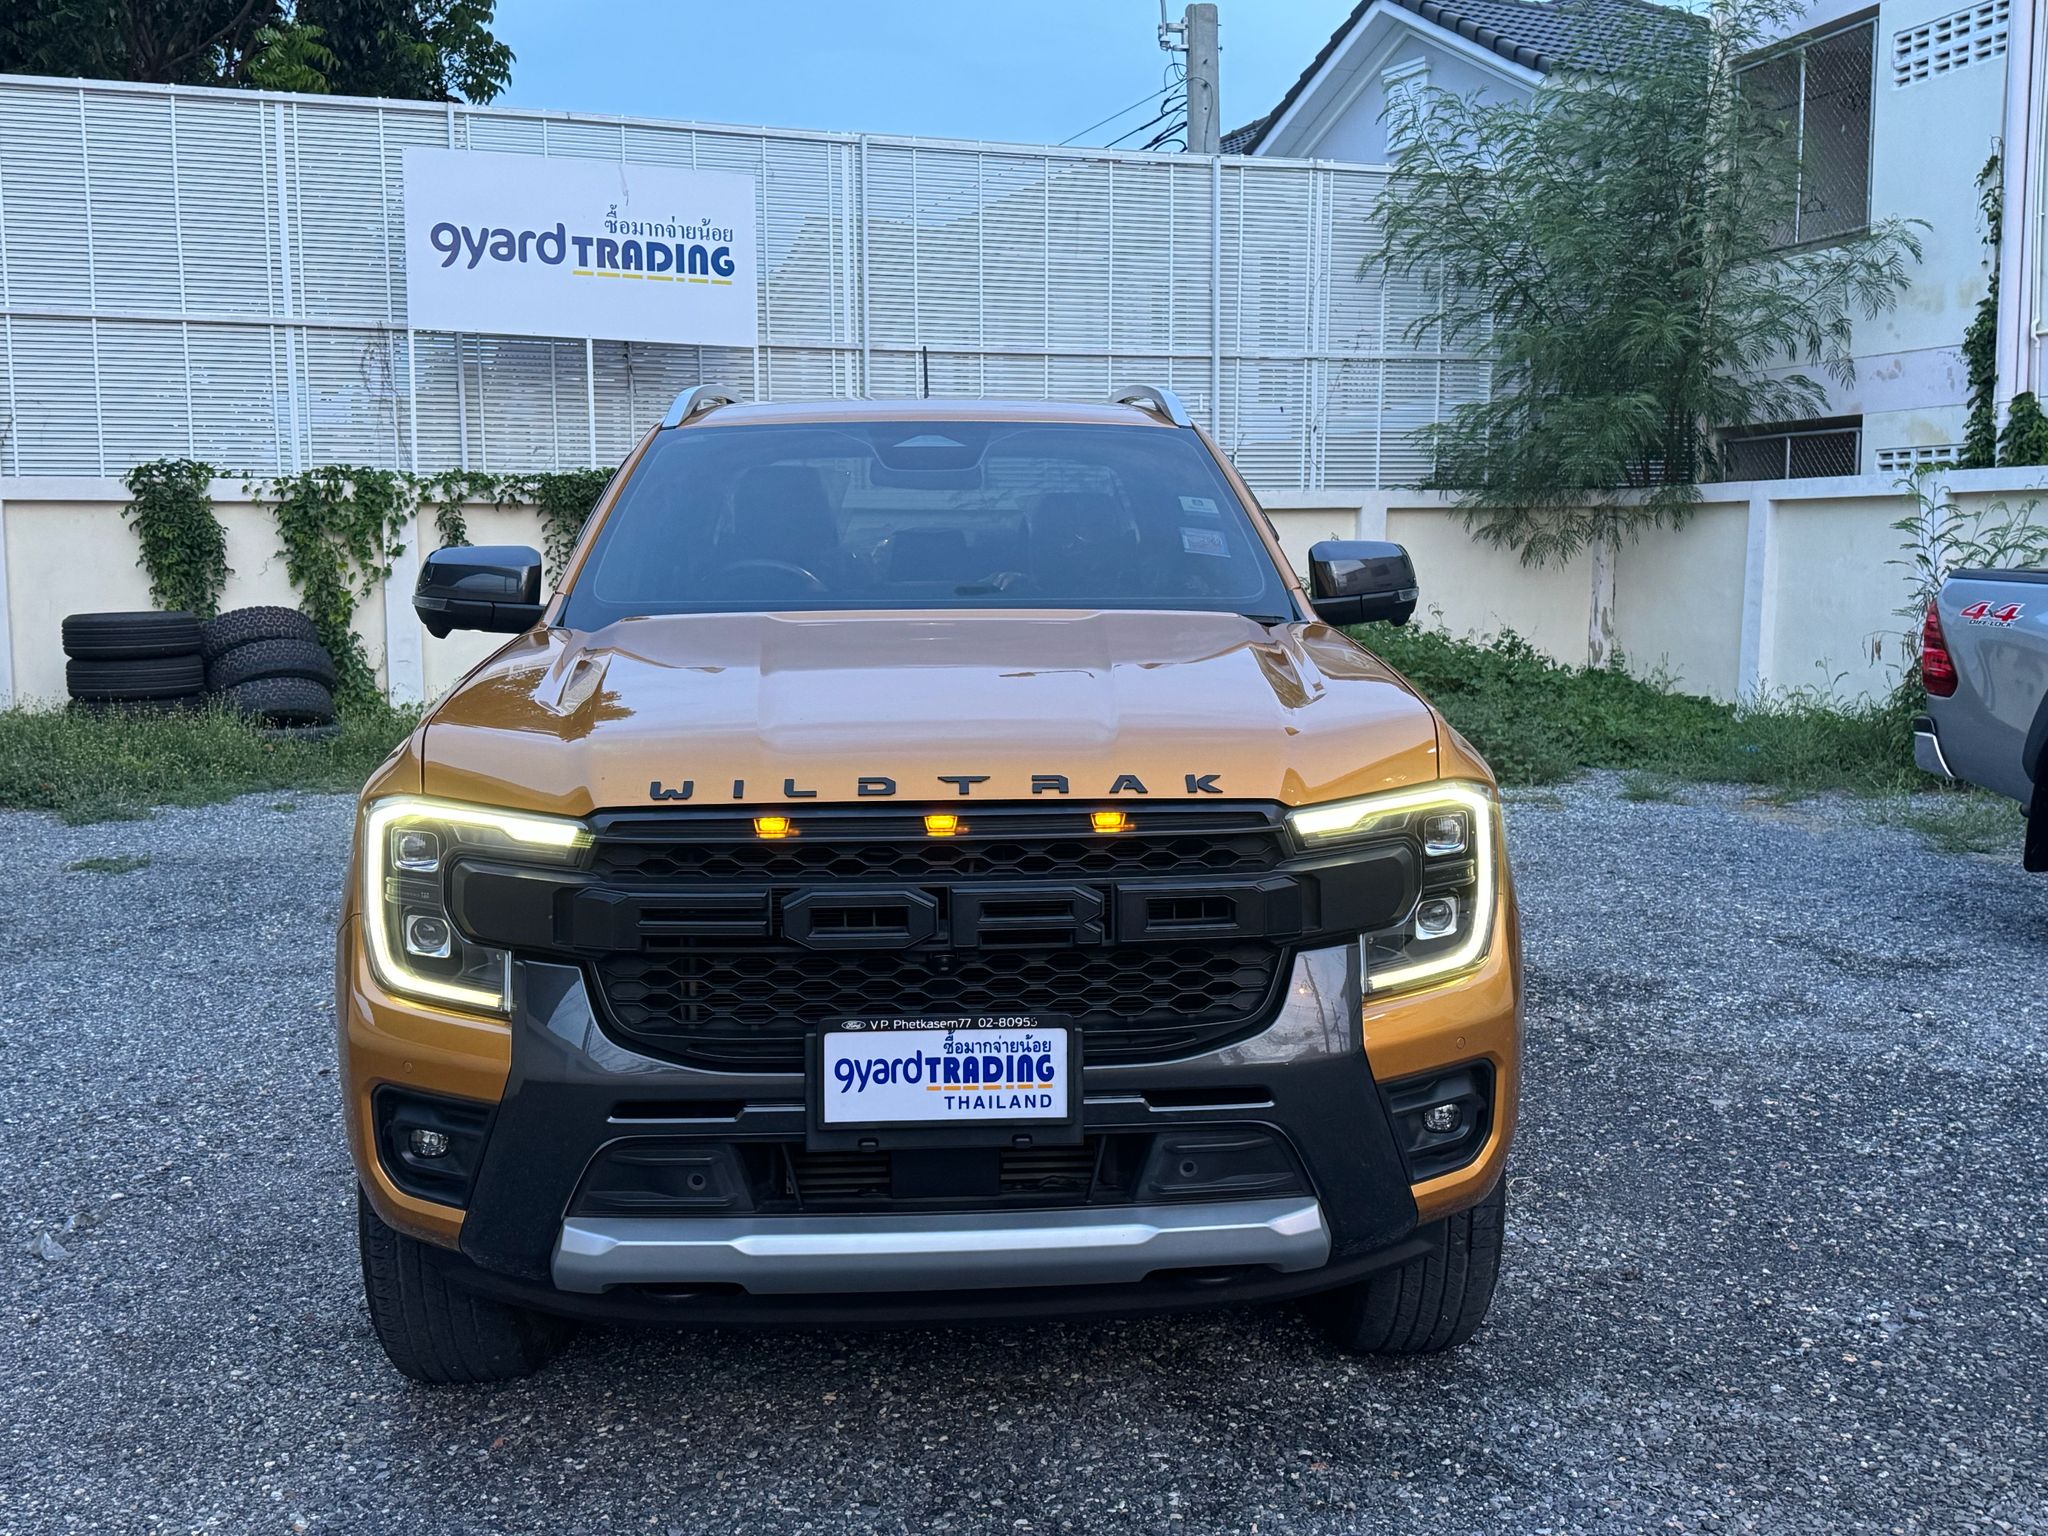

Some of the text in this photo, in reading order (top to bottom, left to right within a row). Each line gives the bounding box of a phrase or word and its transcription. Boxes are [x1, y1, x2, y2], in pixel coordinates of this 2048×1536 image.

[604, 204, 734, 243] ซื้อมากจ่ายน้อย
[649, 773, 1225, 801] WILDTRAK
[943, 1093, 1053, 1111] THAILAND
